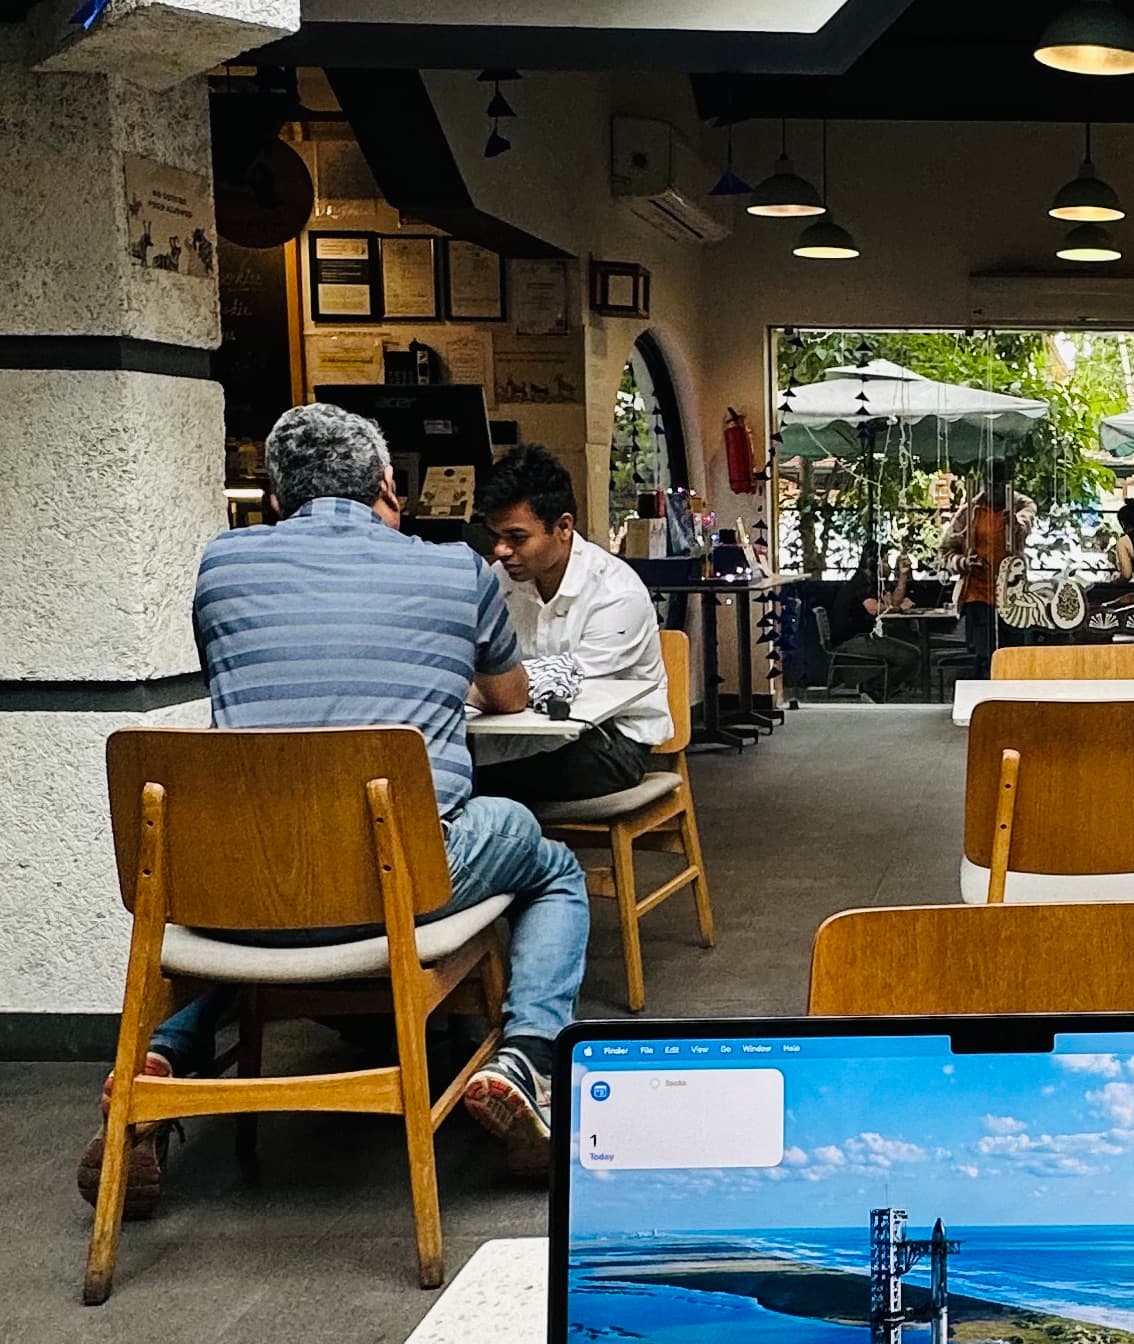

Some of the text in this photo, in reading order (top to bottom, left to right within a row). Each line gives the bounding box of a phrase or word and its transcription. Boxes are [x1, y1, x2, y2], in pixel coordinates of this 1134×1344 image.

[375, 396, 417, 409] acer
[603, 1046, 629, 1055] Finder
[639, 1046, 654, 1054] File
[664, 1046, 680, 1054] Edit
[690, 1045, 710, 1054] View
[720, 1045, 732, 1053] Go
[742, 1044, 772, 1053] Window
[589, 1134, 597, 1148] 1
[589, 1152, 615, 1161] Today
